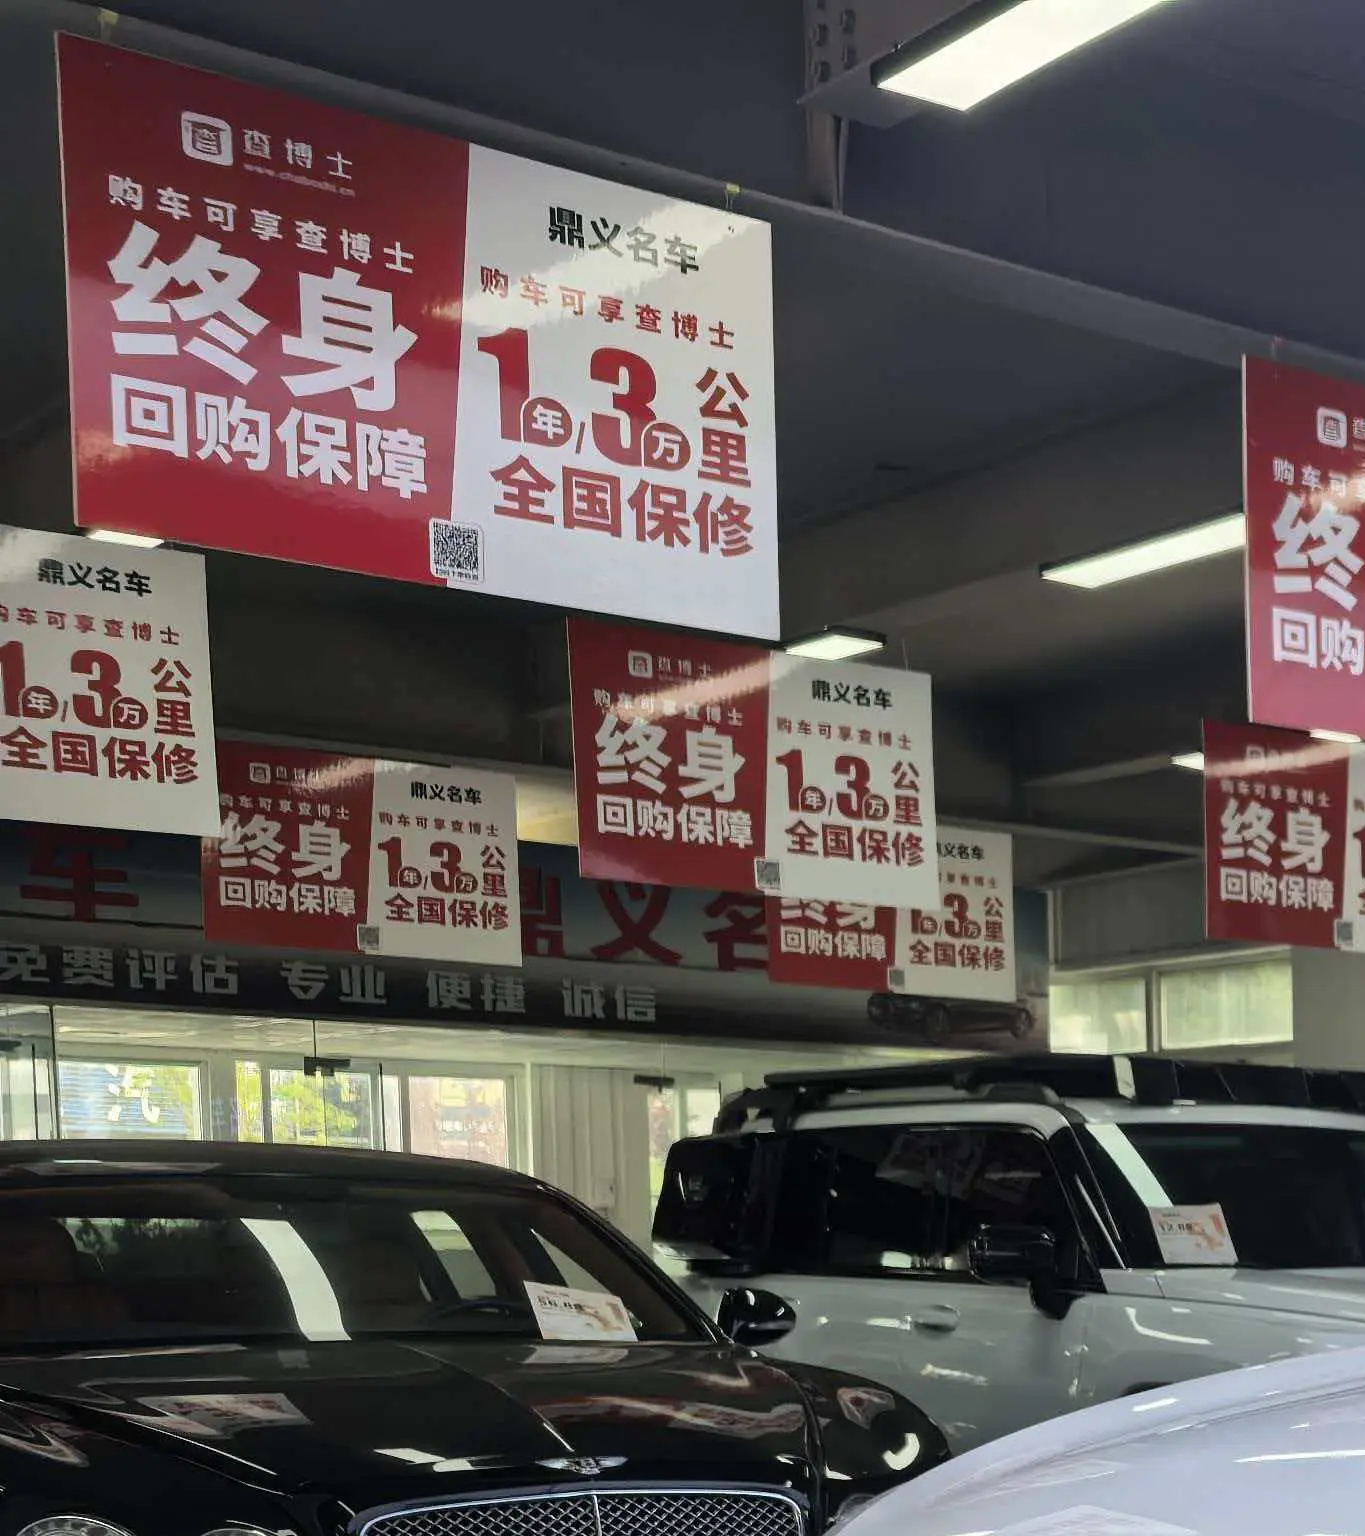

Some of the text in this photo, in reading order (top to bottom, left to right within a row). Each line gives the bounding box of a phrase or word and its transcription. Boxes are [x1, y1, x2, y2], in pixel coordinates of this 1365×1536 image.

[109, 174, 414, 275] 购车可享查博士
[548, 206, 700, 275] 鼎义名车
[107, 221, 418, 411] 终身
[479, 266, 735, 350] 购车可享查博士
[110, 373, 428, 501] 回购保障
[488, 454, 755, 558] 全国保修
[37, 558, 153, 598] 鼎义名车
[811, 679, 893, 711] 鼎义名车
[0, 726, 199, 785] 全国保修
[595, 712, 746, 803] 终身
[410, 781, 483, 806] 鼎义名车
[596, 793, 754, 850] 回购保障
[218, 811, 352, 882] 终身
[784, 819, 926, 868] 全国保修
[937, 842, 984, 861] 义名车
[1220, 797, 1332, 874] 终身
[218, 876, 356, 917] 回购保障
[385, 892, 510, 931] 全国保修
[1220, 866, 1334, 912] 回购保障
[780, 925, 887, 962] 回购保障
[908, 940, 1006, 972] 全国保修
[0, 940, 657, 1023] 免费评估 专业 便捷 诚信
